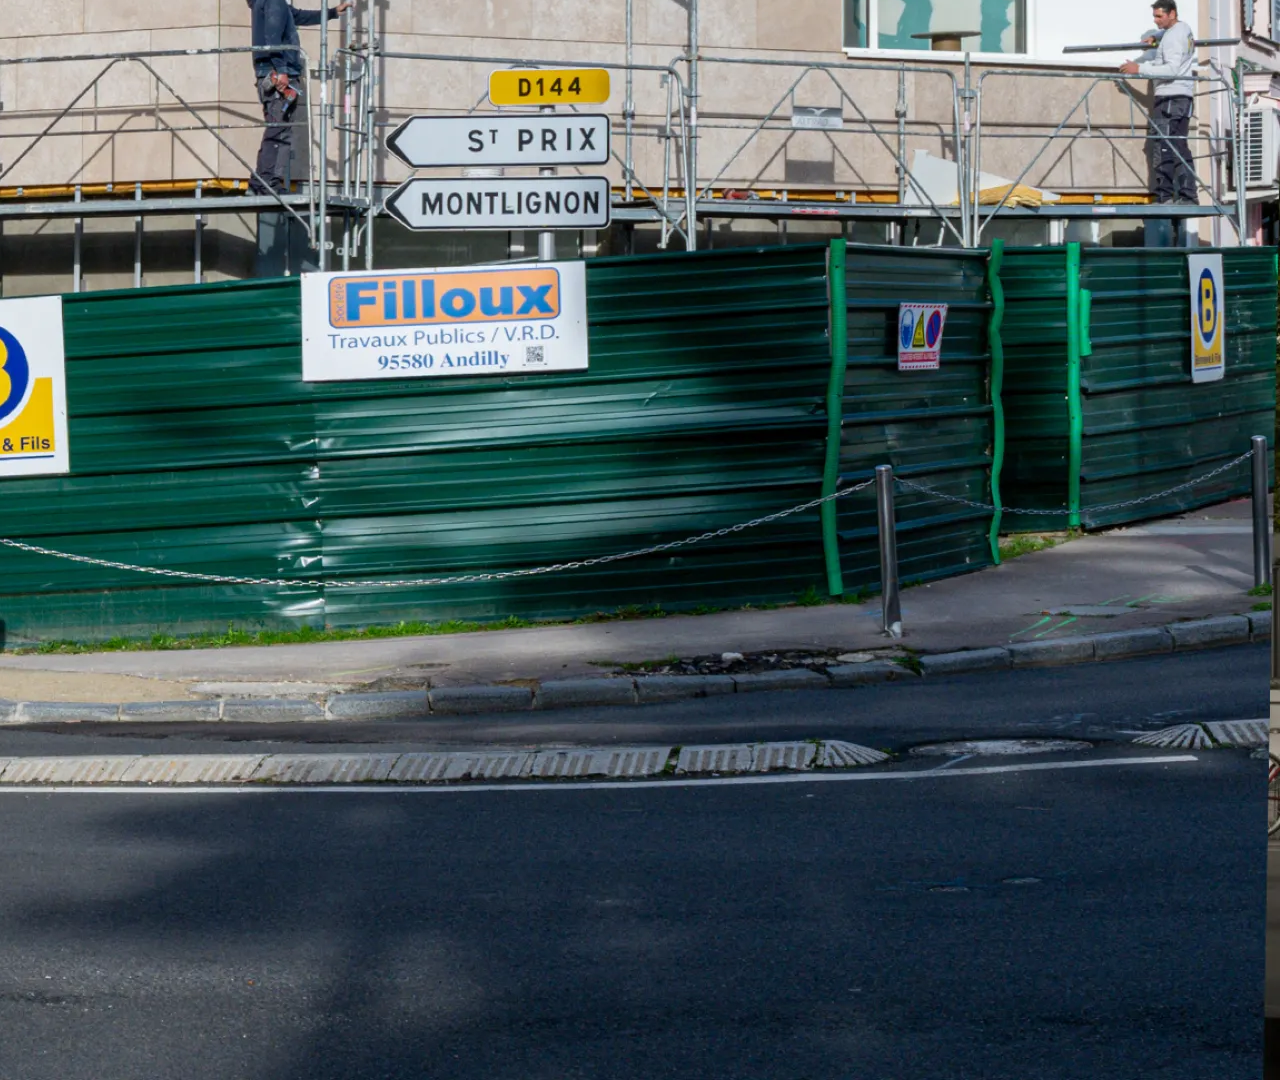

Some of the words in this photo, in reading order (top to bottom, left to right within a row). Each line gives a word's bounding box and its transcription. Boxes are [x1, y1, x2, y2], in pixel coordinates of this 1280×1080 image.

[518, 77, 582, 97] D144
[518, 127, 596, 152] PRIX
[421, 191, 600, 216] MONTLIGNON
[346, 279, 555, 322] Filloux
[1201, 277, 1215, 333] B
[328, 333, 407, 350] Travaux
[414, 327, 486, 346] Publics
[491, 327, 499, 343] /
[505, 324, 560, 342] V.R.D.
[378, 353, 434, 371] 95580
[440, 350, 510, 369] Andilly
[2, 438, 14, 452] &
[20, 436, 51, 451] Fils
